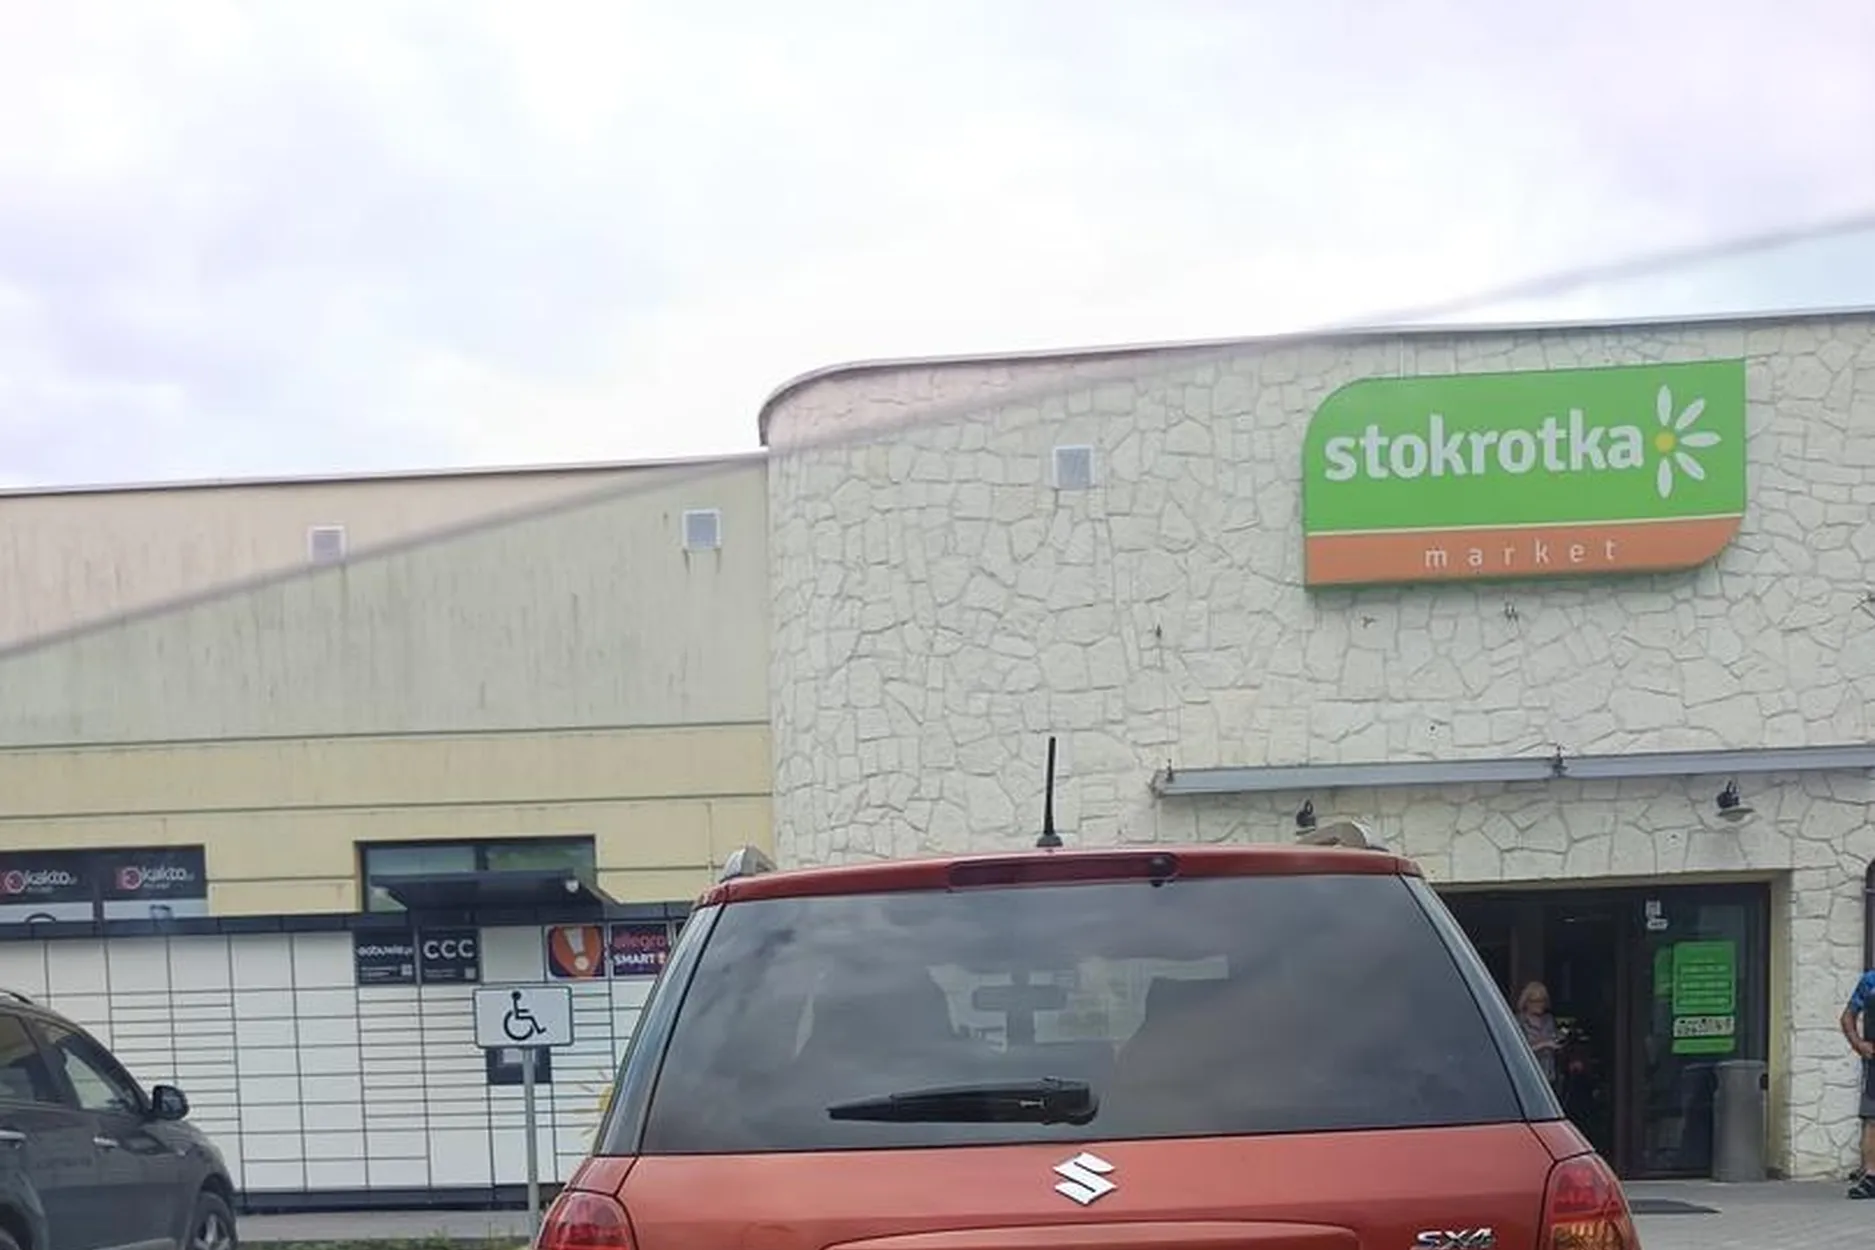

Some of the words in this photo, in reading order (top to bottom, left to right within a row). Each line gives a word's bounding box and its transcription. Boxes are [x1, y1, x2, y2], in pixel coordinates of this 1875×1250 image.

[1324, 408, 1644, 482] stokrotka
[1425, 539, 1618, 568] market
[423, 940, 474, 959] CCC
